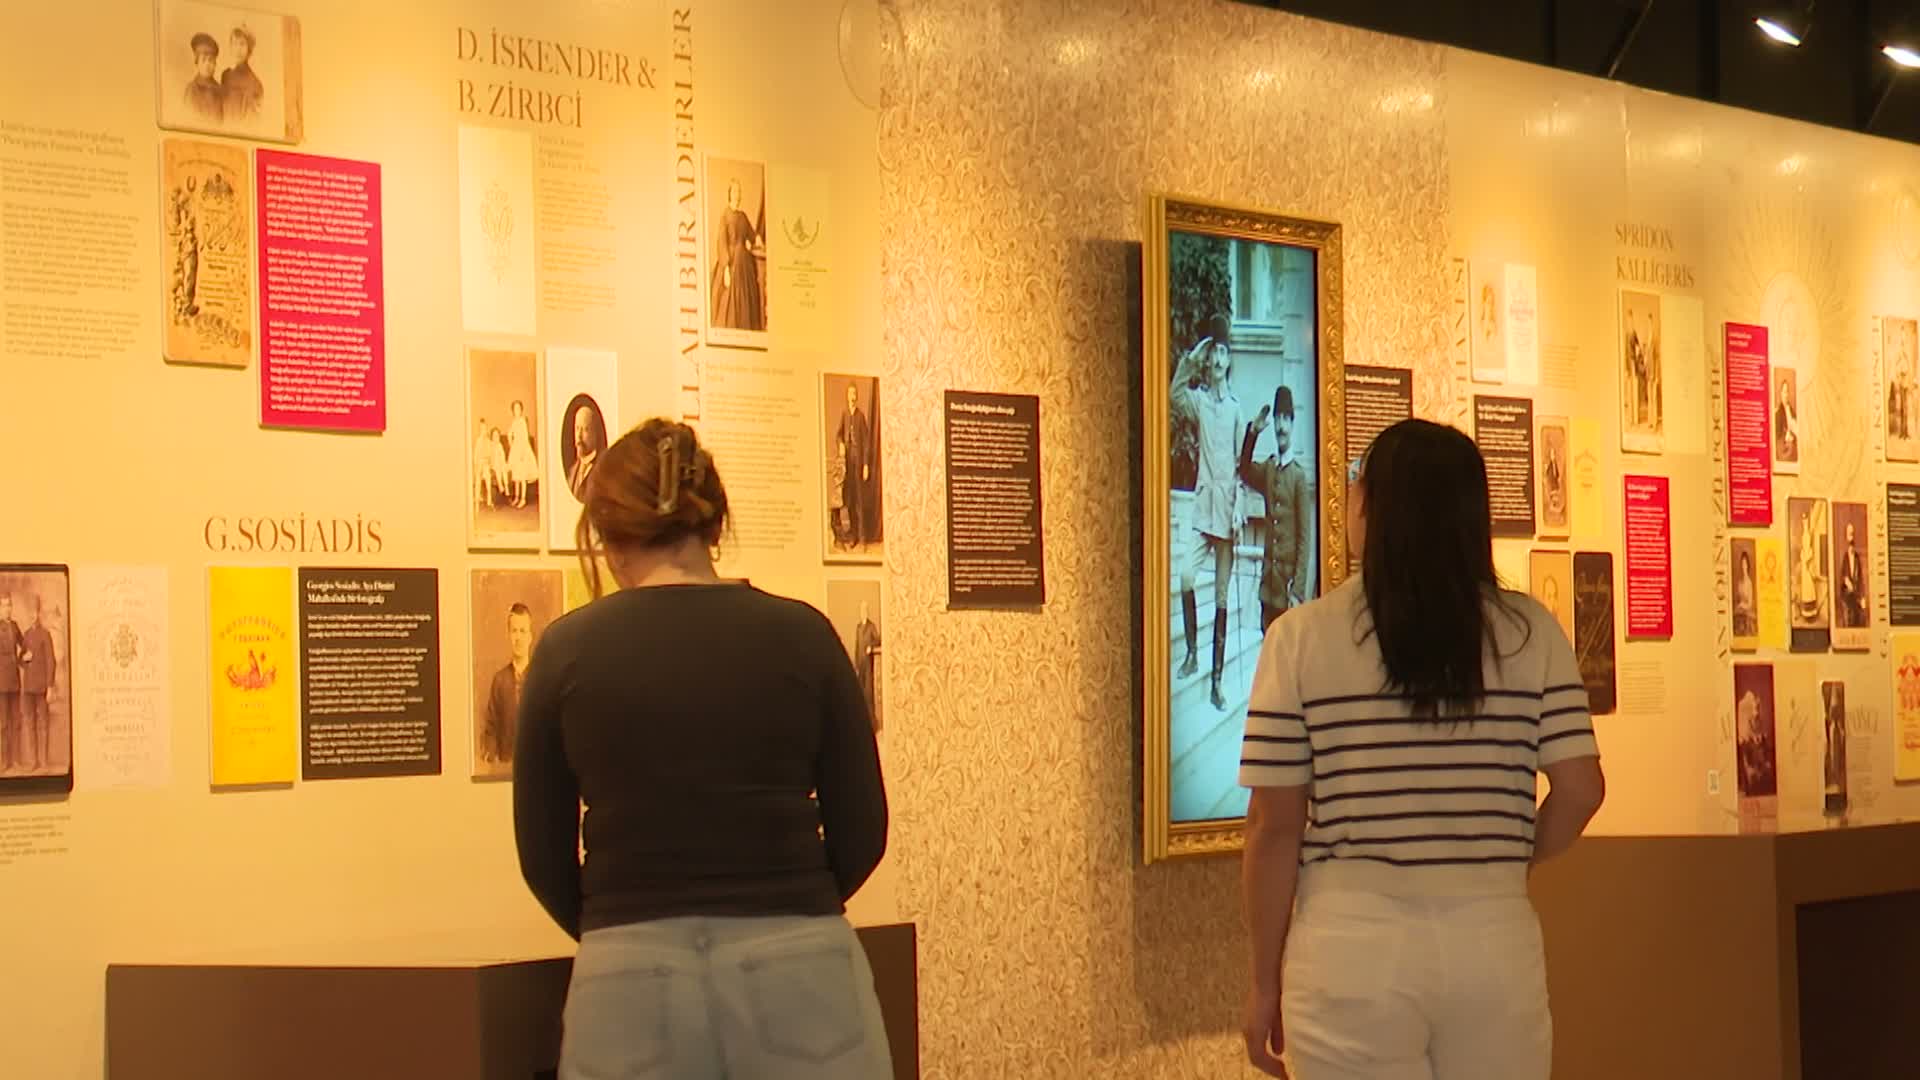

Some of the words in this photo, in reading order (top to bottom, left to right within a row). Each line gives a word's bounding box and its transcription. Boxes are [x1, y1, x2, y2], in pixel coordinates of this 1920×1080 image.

[457, 27, 483, 63] D.
[491, 27, 631, 87] İSKENDER
[637, 56, 657, 89] &
[458, 79, 482, 113] B.
[488, 81, 582, 129] ZİRBCİ
[673, 7, 697, 291] BİRADERLER
[679, 302, 700, 423] LLAH
[204, 512, 383, 553] G.SOSİADİS
